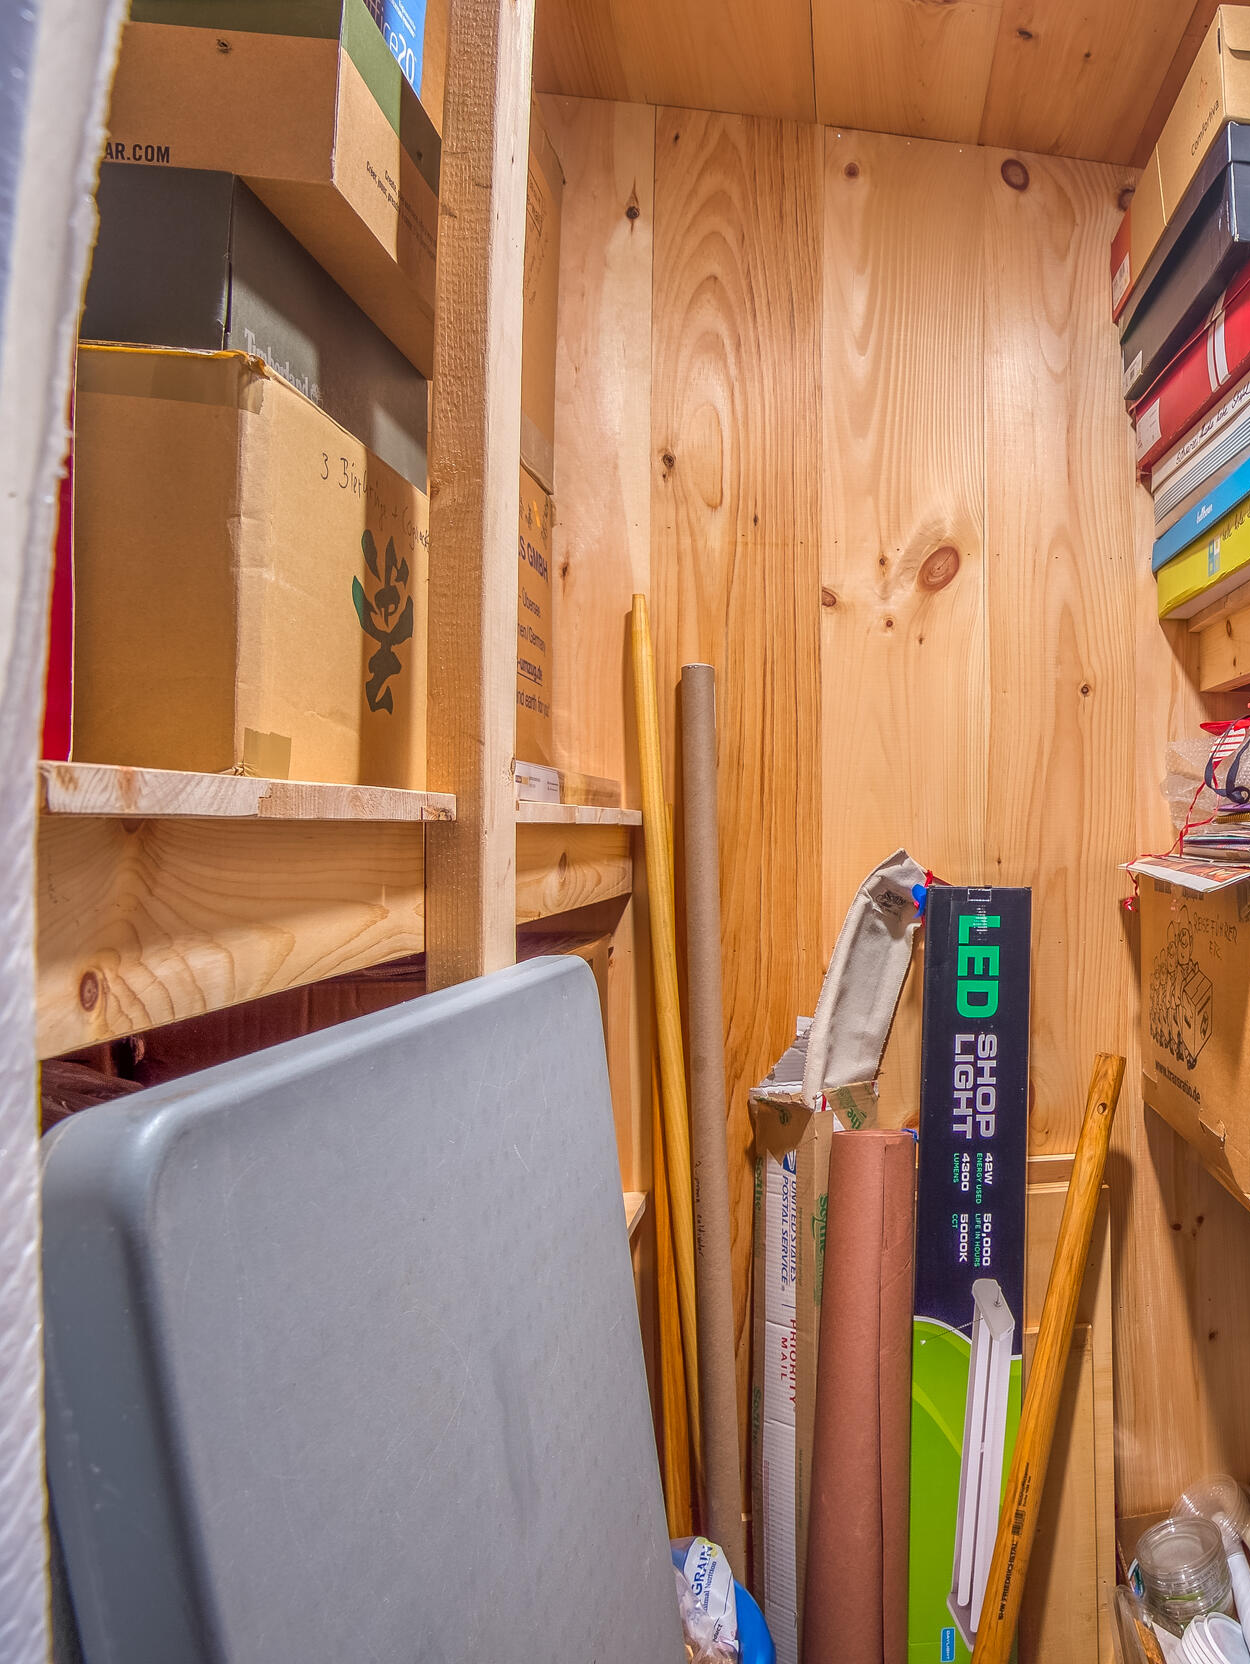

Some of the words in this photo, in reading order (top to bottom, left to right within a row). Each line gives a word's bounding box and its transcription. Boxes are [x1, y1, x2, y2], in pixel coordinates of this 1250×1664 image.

[104, 141, 171, 164] AR.COM
[320, 452, 329, 480] 3
[956, 914, 1001, 1019] LED
[952, 1033, 975, 1140] LIGHT
[975, 1032, 998, 1139] SHOP
[952, 1152, 960, 1183] LUMENS
[961, 1152, 970, 1192] 4300
[975, 1152, 983, 1183] ENERGY
[984, 1152, 993, 1185] 42W
[781, 1175, 789, 1226] POSTAL
[959, 1213, 968, 1263] 5000K
[974, 1231, 981, 1240] IN
[981, 1213, 992, 1266] 50,000
